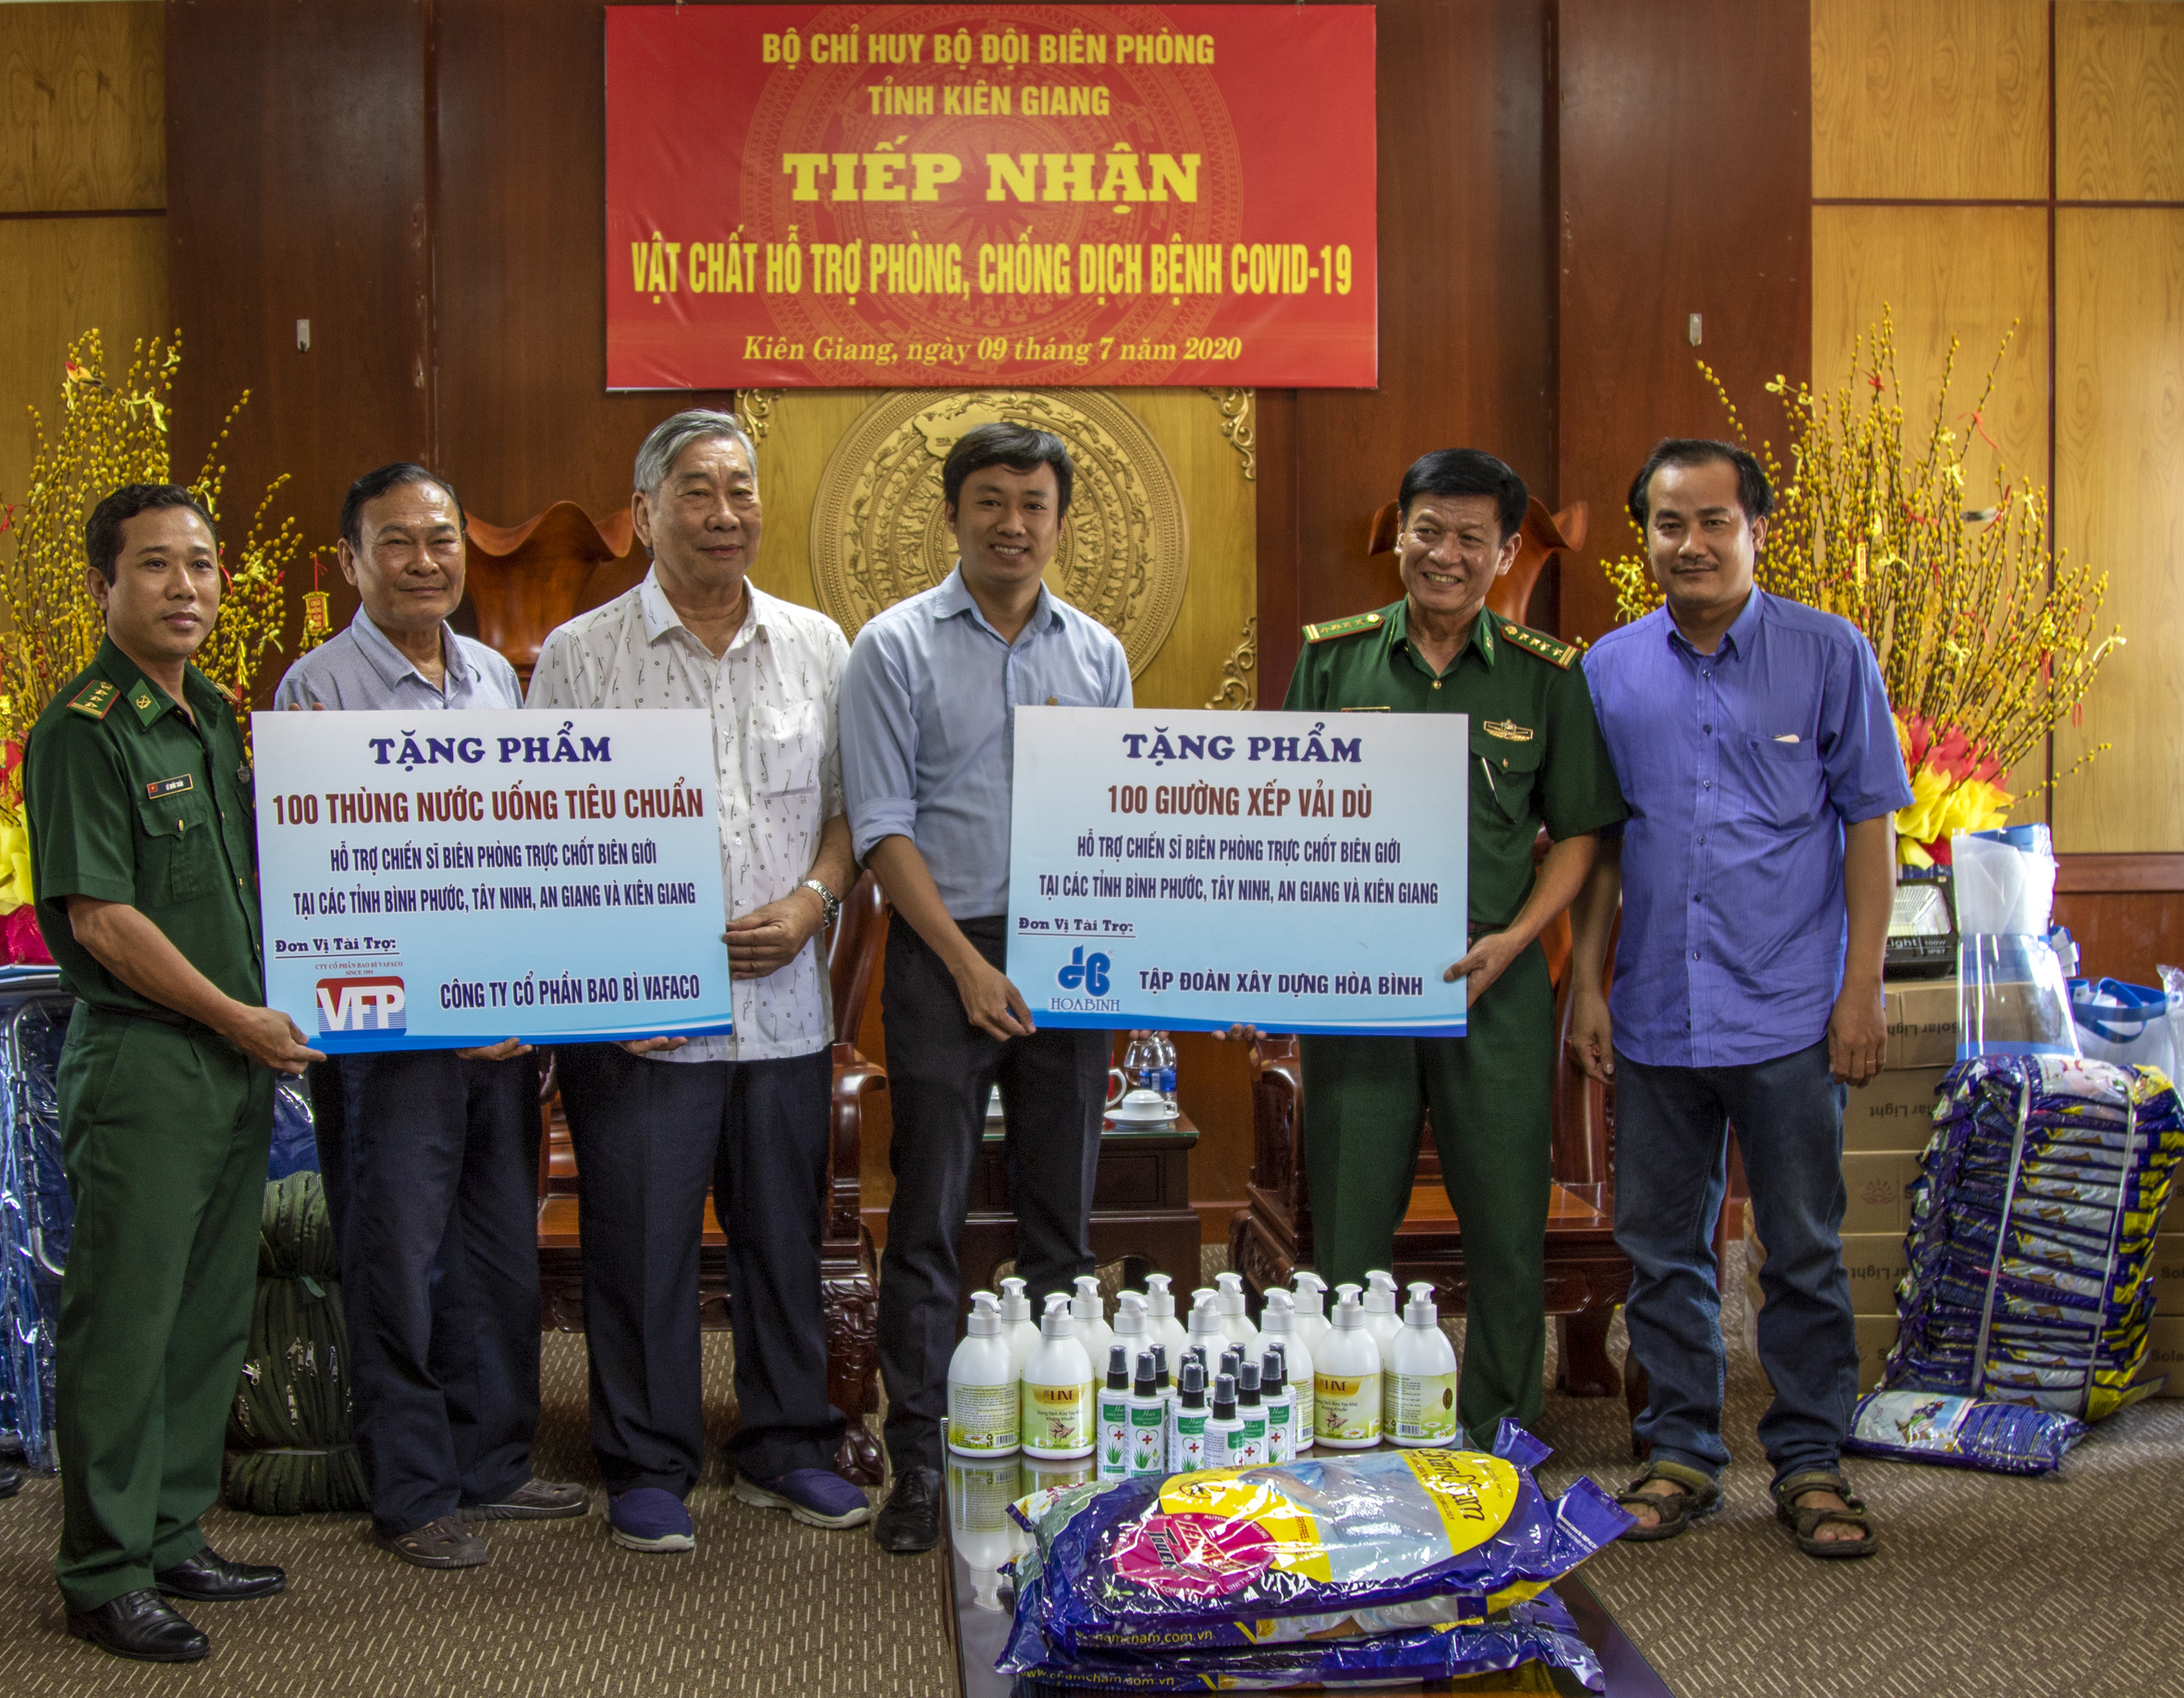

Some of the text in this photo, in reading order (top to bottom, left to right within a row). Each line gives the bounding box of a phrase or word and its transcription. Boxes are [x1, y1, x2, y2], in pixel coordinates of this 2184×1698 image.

[764, 25, 1213, 69] BỘ CHỈ HUY BỘ ĐỘI BIÊN PHÒNG
[868, 77, 1109, 116] TỈNH KIÊN GIANG
[783, 135, 1201, 214] TIẾP NHẬN
[632, 226, 1351, 305] VẬT CHẤT HỖ TRỢ PHÒNG, CHỐNG DỊCH BỆNH COVID-19
[743, 337, 1242, 365] Kiên Giang, ngày 09 tháng 7 năm 2020
[369, 721, 611, 771] TẶNG PHẨM
[1123, 722, 1362, 766] TẶNG PHẨM
[273, 777, 703, 825] 100 THÙNG NƯỚC UỐNG TIÊU CHUẨN
[1109, 779, 1371, 818] 100 GIƯỜNG XẾP VẢI DÙ
[331, 838, 656, 875] HỖ TRỢ CHIẾN SĨ BIÊN PHÒNG TRỰC CHỐT BIÊN GIỚI
[1078, 829, 1400, 866] HỖ TRỢ CHIẾN SĨ BIÊN PHÒNG TRỰC CHỐT BIÊN GIỚI
[293, 880, 695, 920] TẠI CÁC TỈNH BÌNH PHƯỚC, TÂY NINH, AN GIANG VÀ KIÊN GIANG
[1039, 869, 1438, 904] TẠI CÁC TỈNH BÌNH PHƯỚC, TÂY NINH, AN GIANG VÀ KIÊN GIANG
[1019, 917, 1133, 931] Đơn Vị Tài Trợ:
[276, 937, 396, 954] Đơn Vị Tài Trợ:
[1886, 937, 1919, 950] ight
[441, 971, 699, 1009] CÔNG TY CỔ PHẦN BAO BÌ VAFACO
[1139, 967, 1422, 997] TẬP ĐOÀN XÂY DỰNG HÒA BÌNH
[316, 985, 405, 1030] VFP
[1886, 1023, 1918, 1037] Ligh
[1869, 1103, 1908, 1118] Light
[1851, 1264, 1891, 1281] Light
